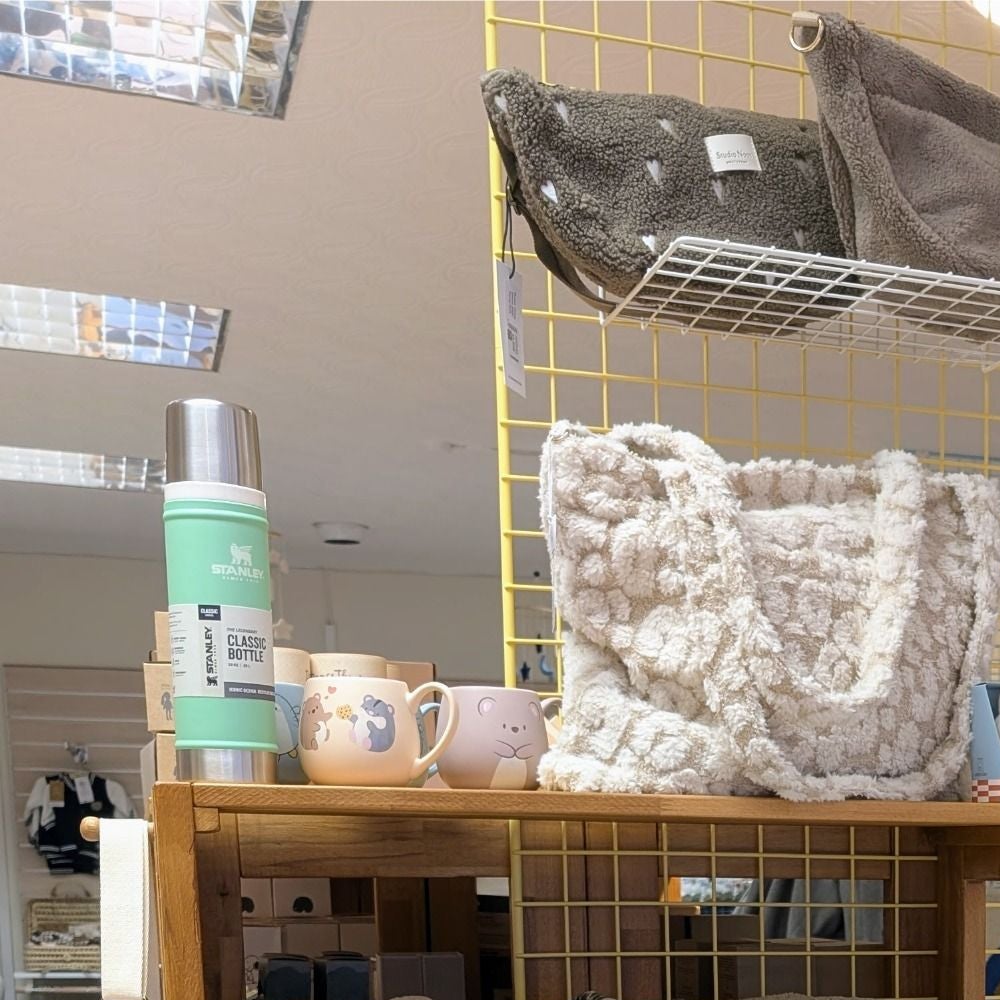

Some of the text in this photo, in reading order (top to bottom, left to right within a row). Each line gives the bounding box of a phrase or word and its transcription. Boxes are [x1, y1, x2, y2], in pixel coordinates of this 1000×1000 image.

[211, 564, 264, 578] STANLEY
[204, 626, 214, 674] STANLEY
[227, 634, 267, 650] CLASSIC
[228, 647, 264, 663] BOTTLE
